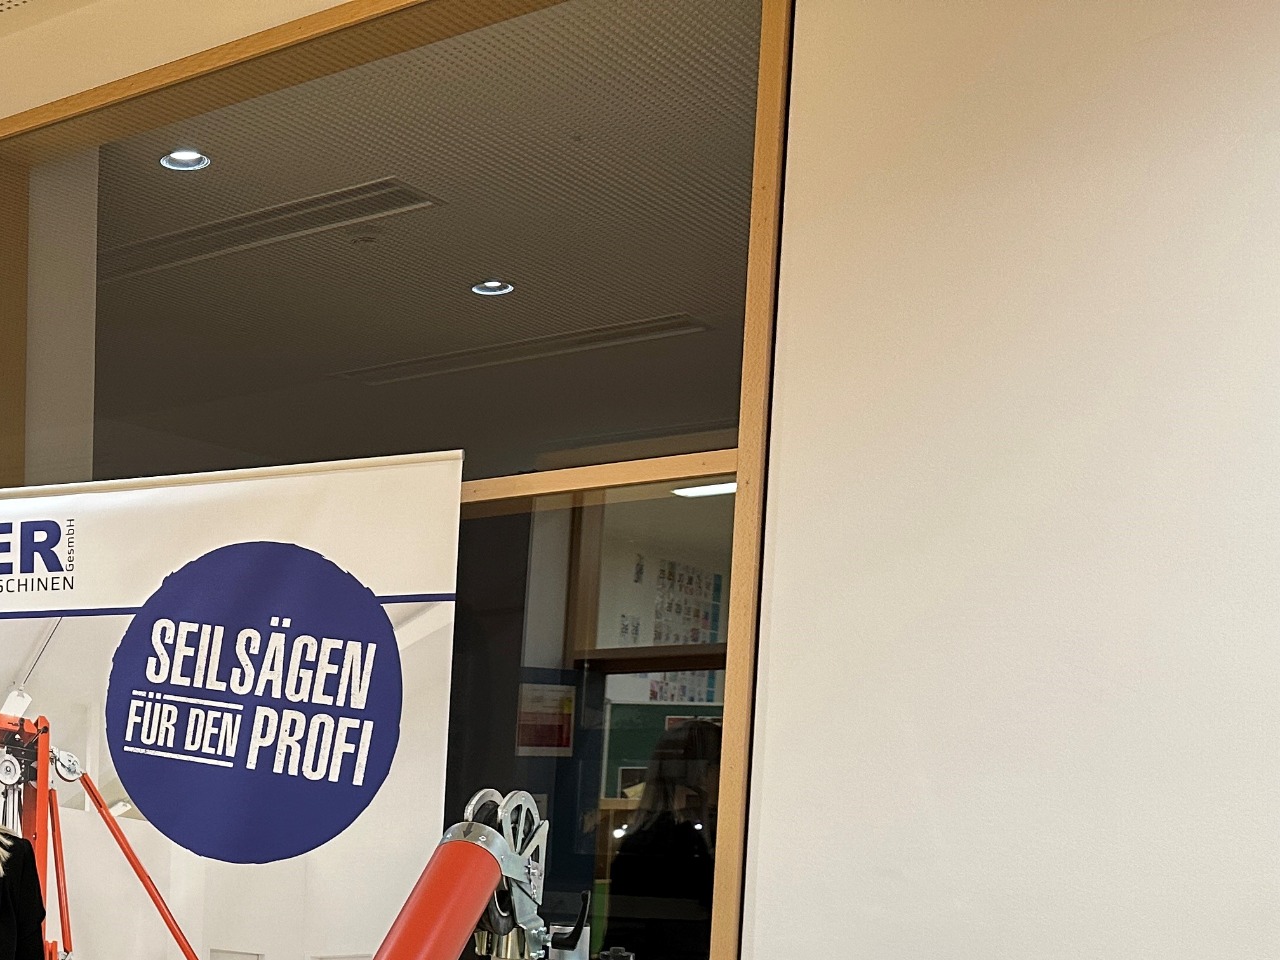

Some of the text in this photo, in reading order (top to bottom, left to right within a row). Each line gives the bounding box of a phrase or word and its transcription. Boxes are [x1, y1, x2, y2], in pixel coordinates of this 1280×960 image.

[65, 518, 75, 572] GesmbH
[146, 616, 377, 710] SEILSÄGEN
[125, 692, 374, 786] FÜR DEN PROFI
